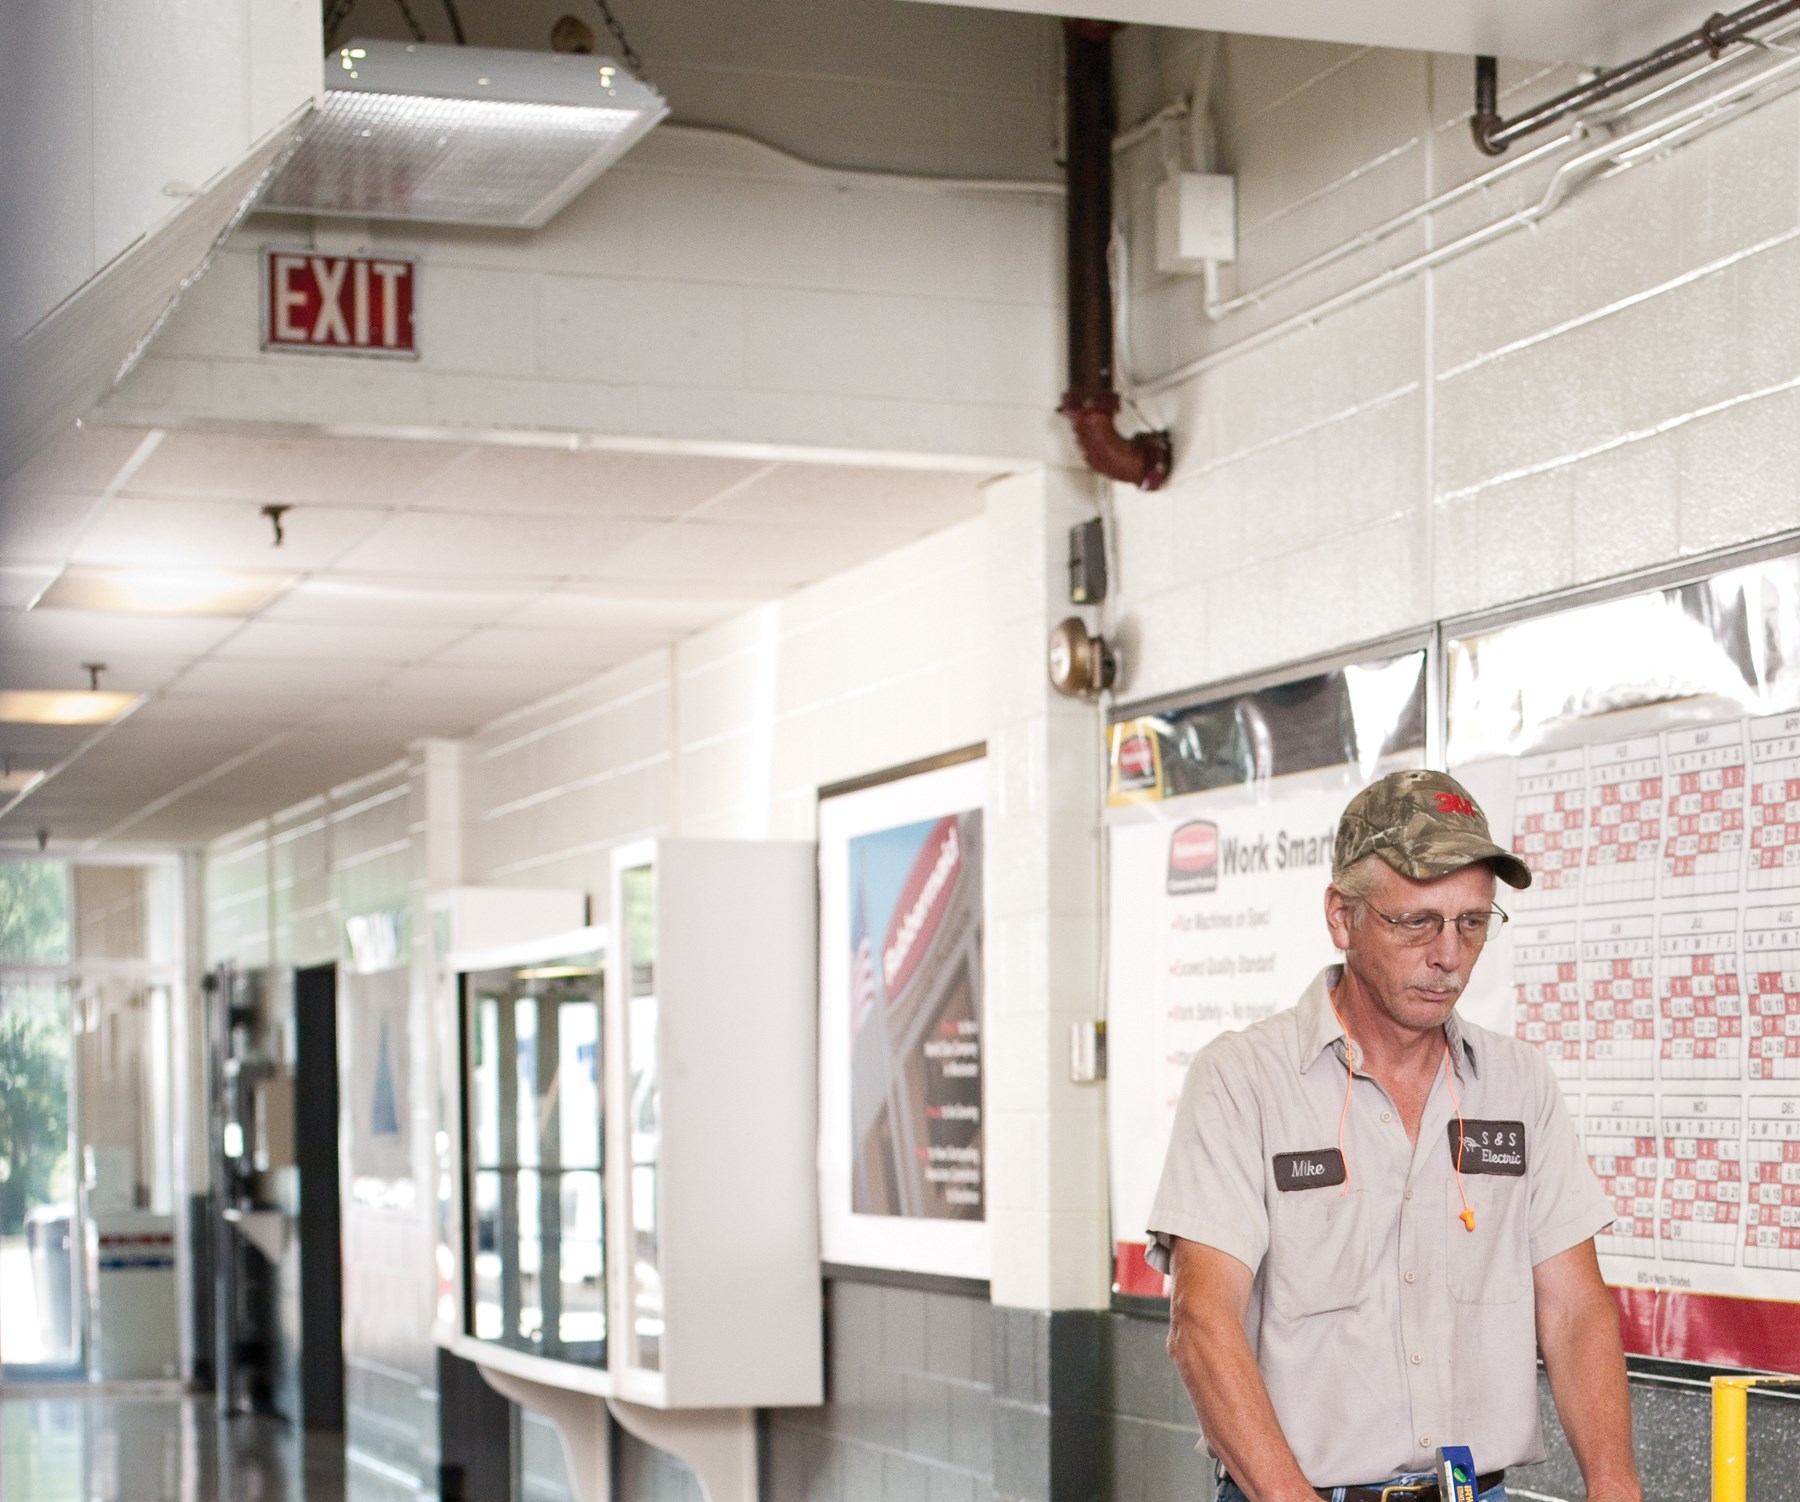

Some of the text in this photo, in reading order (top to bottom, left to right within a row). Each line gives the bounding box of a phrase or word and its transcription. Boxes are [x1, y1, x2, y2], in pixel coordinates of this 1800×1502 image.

[275, 256, 408, 346] EXIT
[1784, 717, 1800, 731] APR
[1433, 792, 1476, 818] 3M
[1222, 834, 1269, 876] Work
[1275, 826, 1335, 871] Smart
[1777, 910, 1793, 923] AUG
[1481, 1131, 1516, 1147] S & S
[1481, 1148, 1522, 1165] Electric
[1291, 1160, 1325, 1177] Mike
